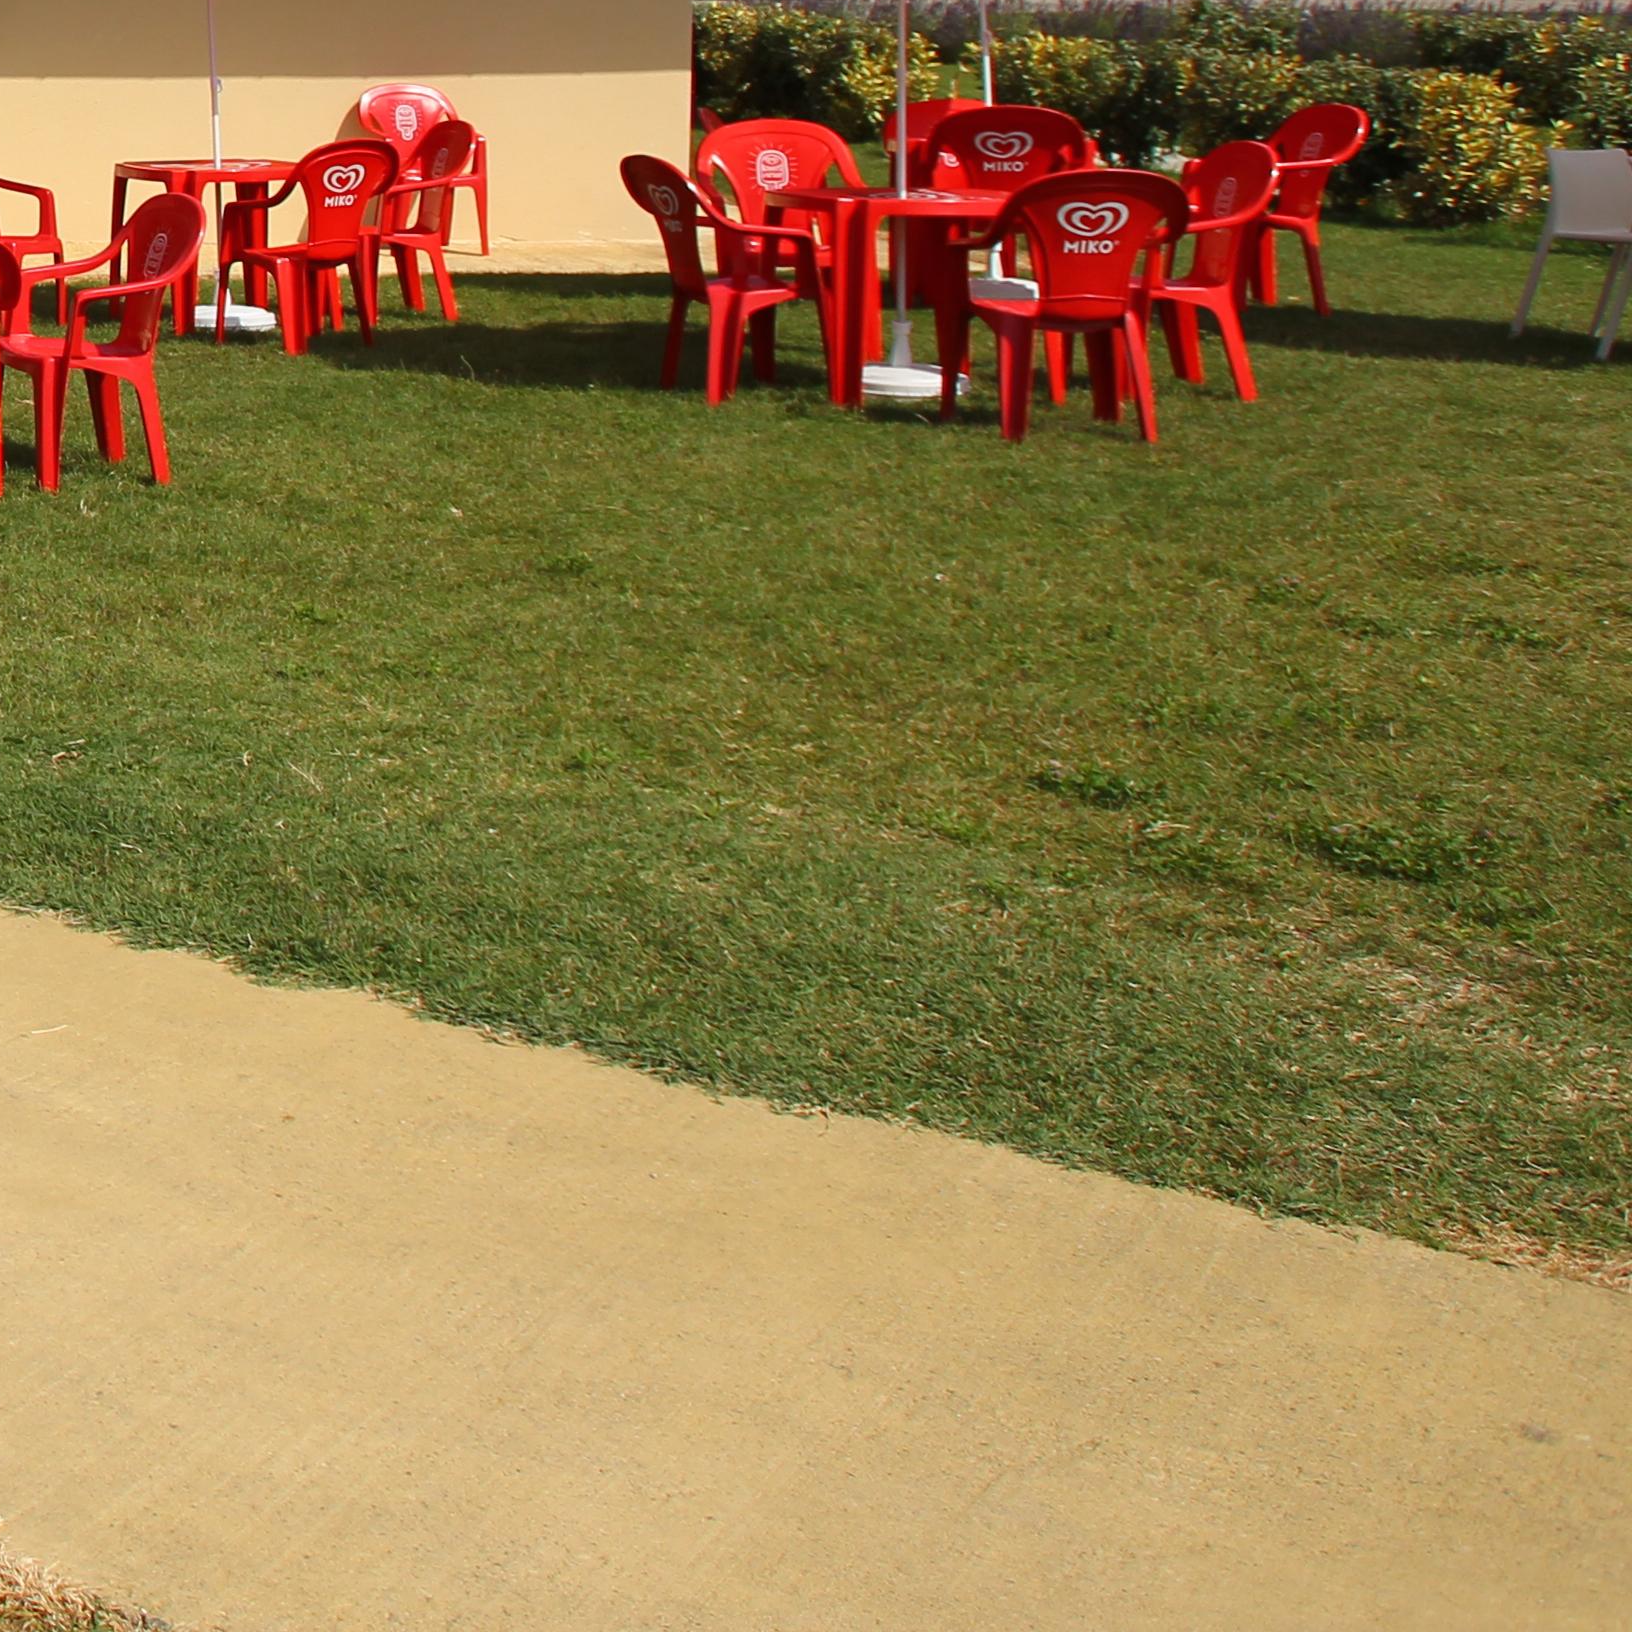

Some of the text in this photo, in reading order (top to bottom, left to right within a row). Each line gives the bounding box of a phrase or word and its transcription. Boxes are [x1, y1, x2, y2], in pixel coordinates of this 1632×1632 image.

[983, 161, 1025, 172] MIKO
[324, 194, 355, 207] MIKO
[1063, 239, 1114, 254] MIKO
